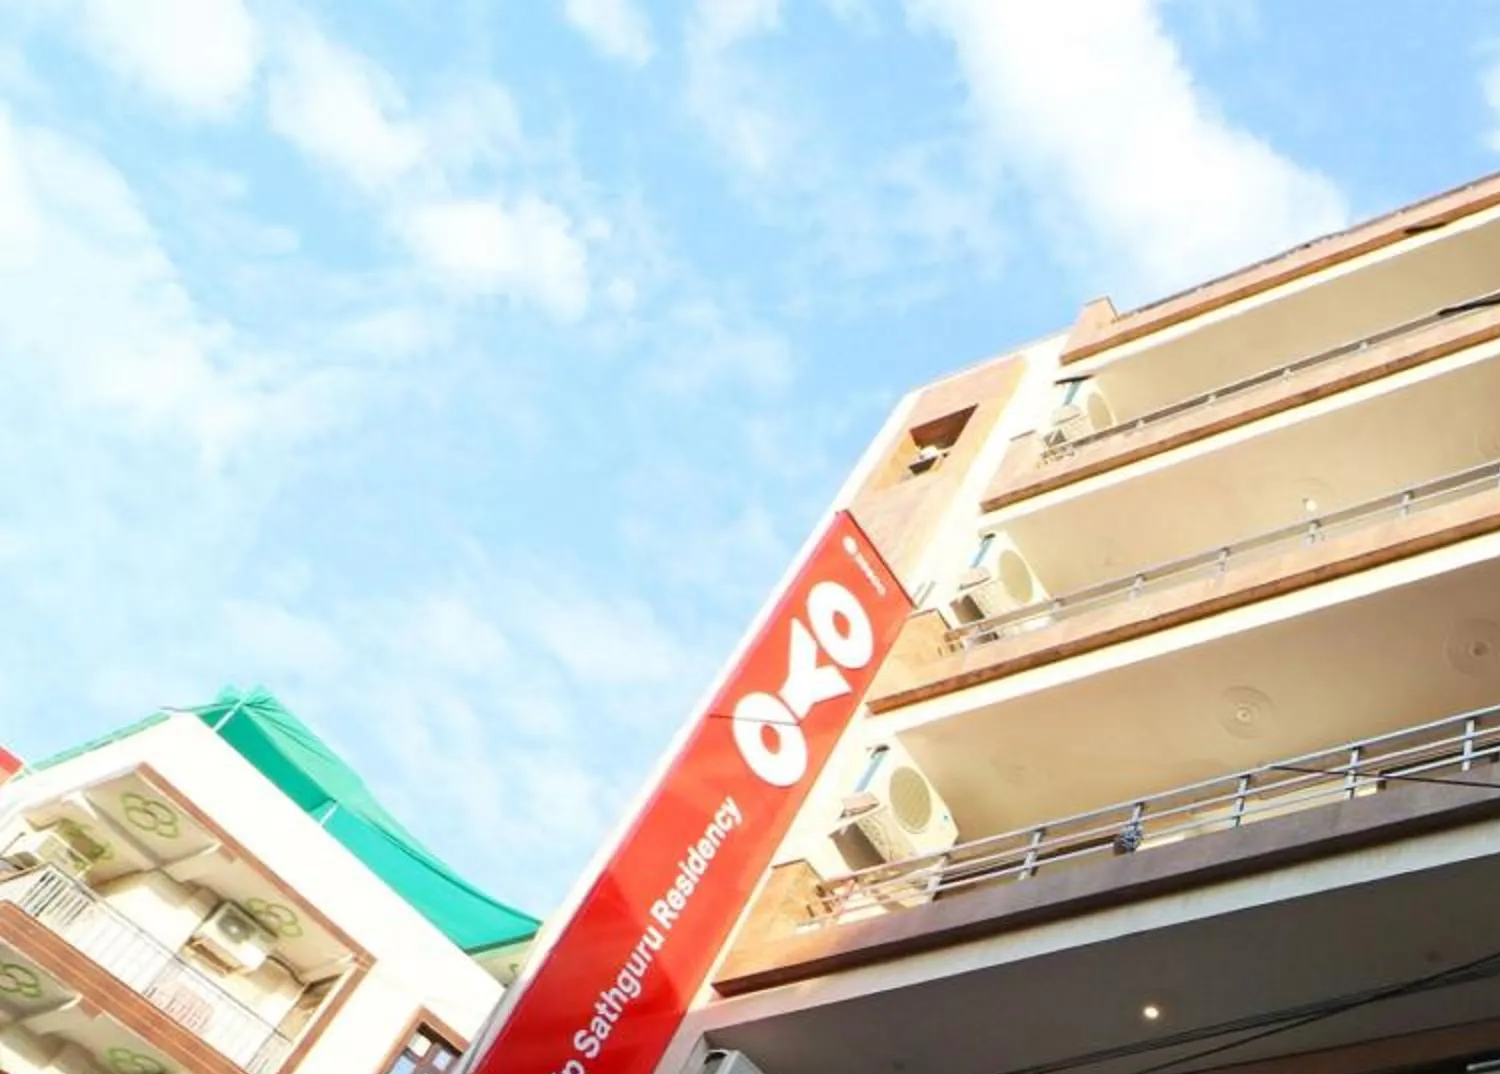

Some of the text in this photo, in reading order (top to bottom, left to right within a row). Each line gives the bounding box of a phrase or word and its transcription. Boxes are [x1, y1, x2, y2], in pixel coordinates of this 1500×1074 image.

[731, 580, 875, 787] OYO
[572, 910, 664, 1062] Sathguru
[650, 795, 744, 926] Residency
